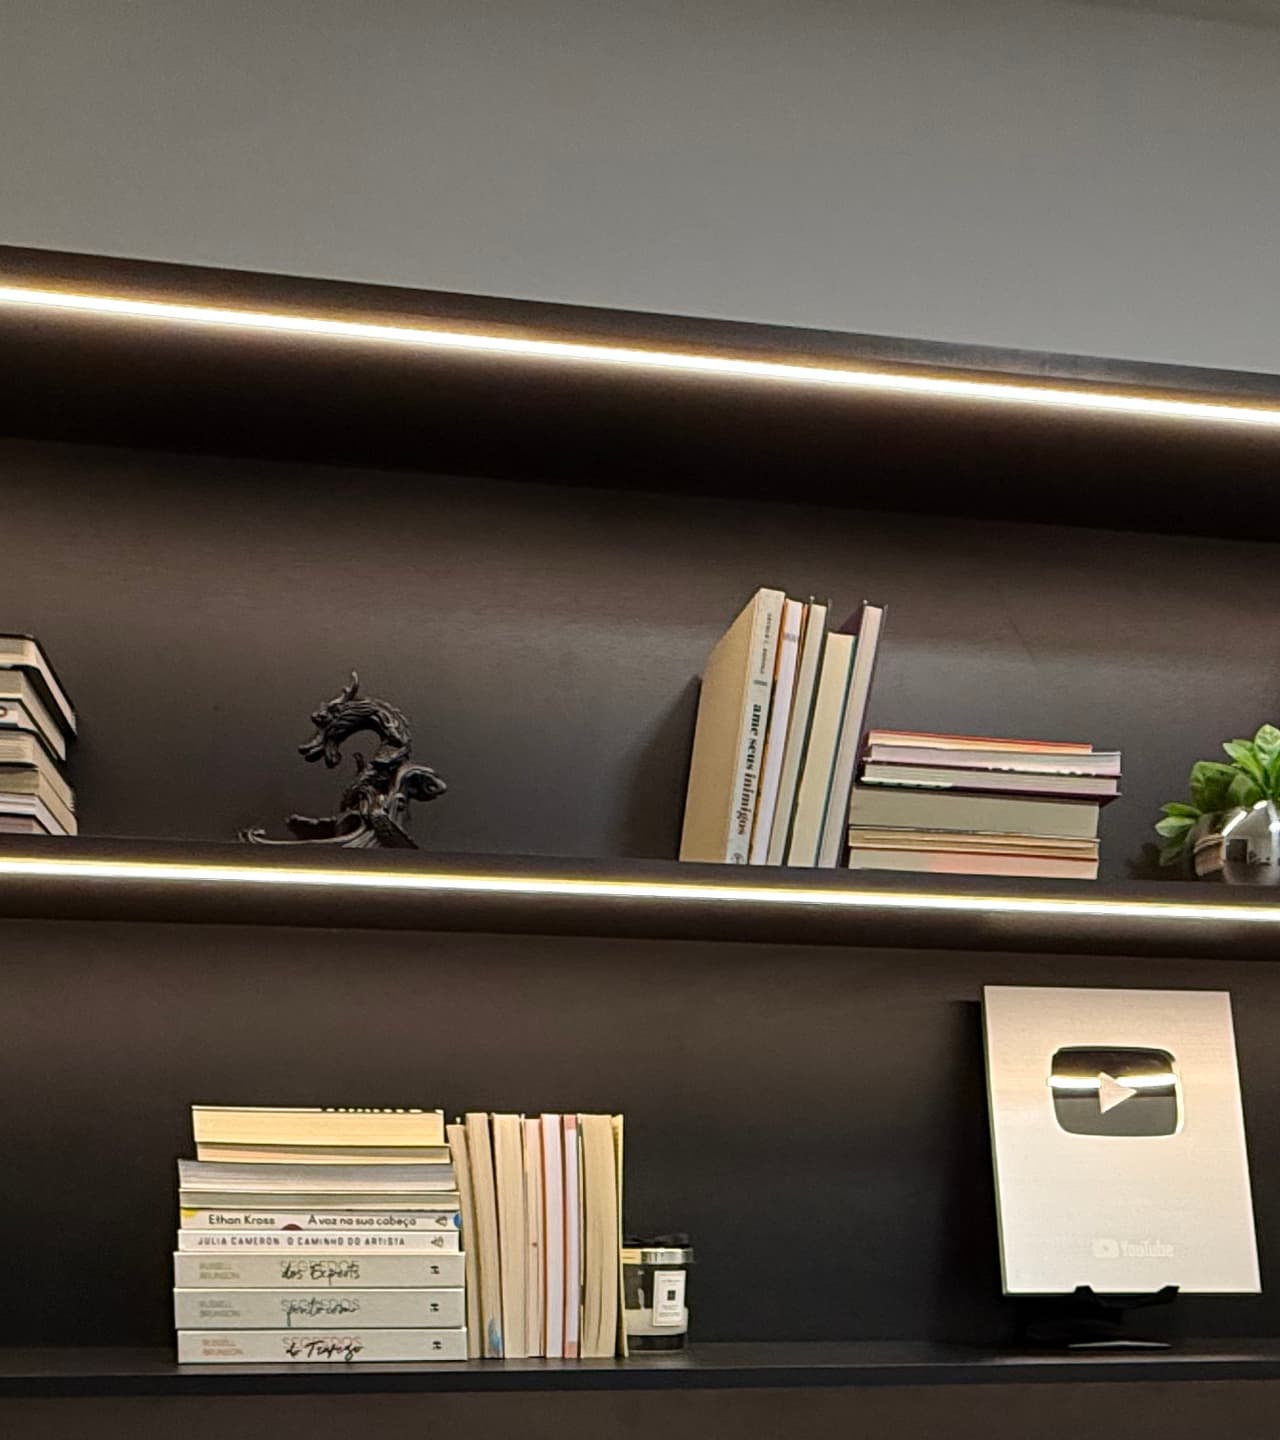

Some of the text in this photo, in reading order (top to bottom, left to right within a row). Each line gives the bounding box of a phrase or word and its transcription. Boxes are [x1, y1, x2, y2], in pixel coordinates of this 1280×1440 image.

[745, 736, 758, 771] seus
[736, 772, 754, 836] inimigos
[208, 1214, 276, 1225] Ethan Kross
[308, 1214, 417, 1228] A voz na sua cabeça
[198, 1237, 280, 1246] JULIA CAMERON
[287, 1236, 405, 1246] O CAMINHO DO ARTISTA
